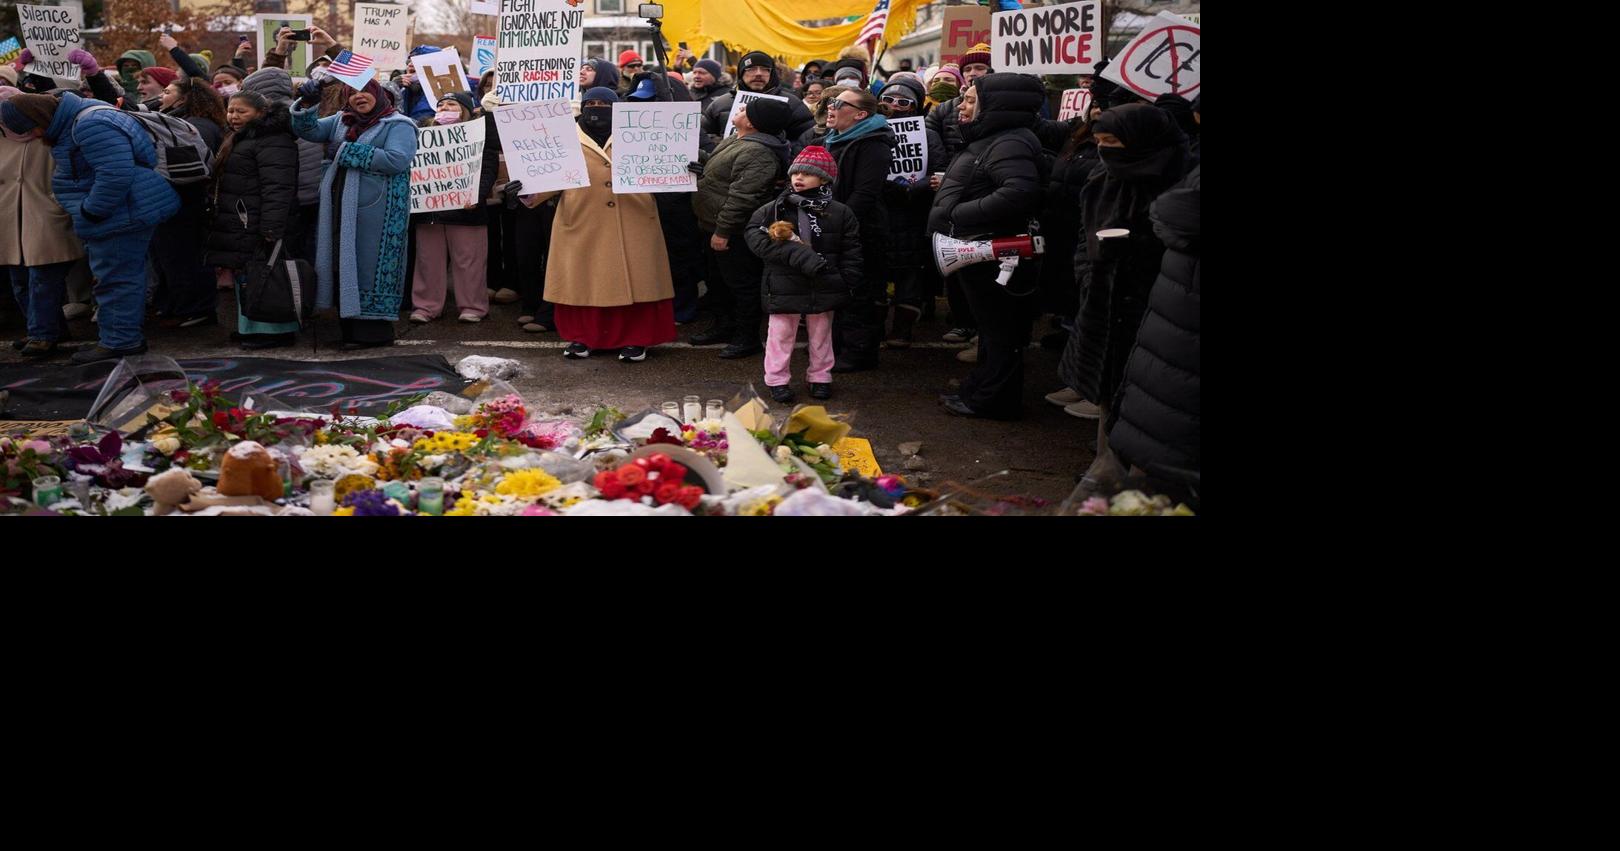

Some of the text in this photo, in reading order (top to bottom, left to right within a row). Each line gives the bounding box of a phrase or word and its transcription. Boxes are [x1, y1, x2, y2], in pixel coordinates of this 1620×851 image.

[22, 5, 72, 24] Silence
[361, 7, 400, 18] TRUMP
[501, 10, 584, 30] IGNORANCE NOT
[364, 18, 380, 26] HAS
[999, 4, 1095, 37] NO MORE
[22, 22, 80, 47] Encourages
[499, 29, 570, 48] IMMIGRANTS
[361, 38, 400, 50] MY DAD
[1005, 33, 1093, 67] MN NICE
[498, 57, 576, 72] STOP PRETENDING
[498, 70, 573, 84] YOUR RACISM IS
[496, 82, 575, 102] PATRIOTISM
[497, 102, 572, 124] JUSTICE
[618, 110, 702, 130] ICE GET
[532, 122, 548, 135] 4
[888, 120, 920, 133] TICE
[447, 126, 468, 144] ARE
[621, 130, 688, 143] OUT OF MN
[648, 144, 667, 152] AND
[891, 143, 923, 159] ENEE
[520, 149, 568, 163] NICOLE
[621, 155, 650, 164] STOP
[527, 162, 562, 177] GOOD
[617, 166, 631, 175] SO
[888, 158, 923, 174] OOD
[435, 181, 453, 192] the
